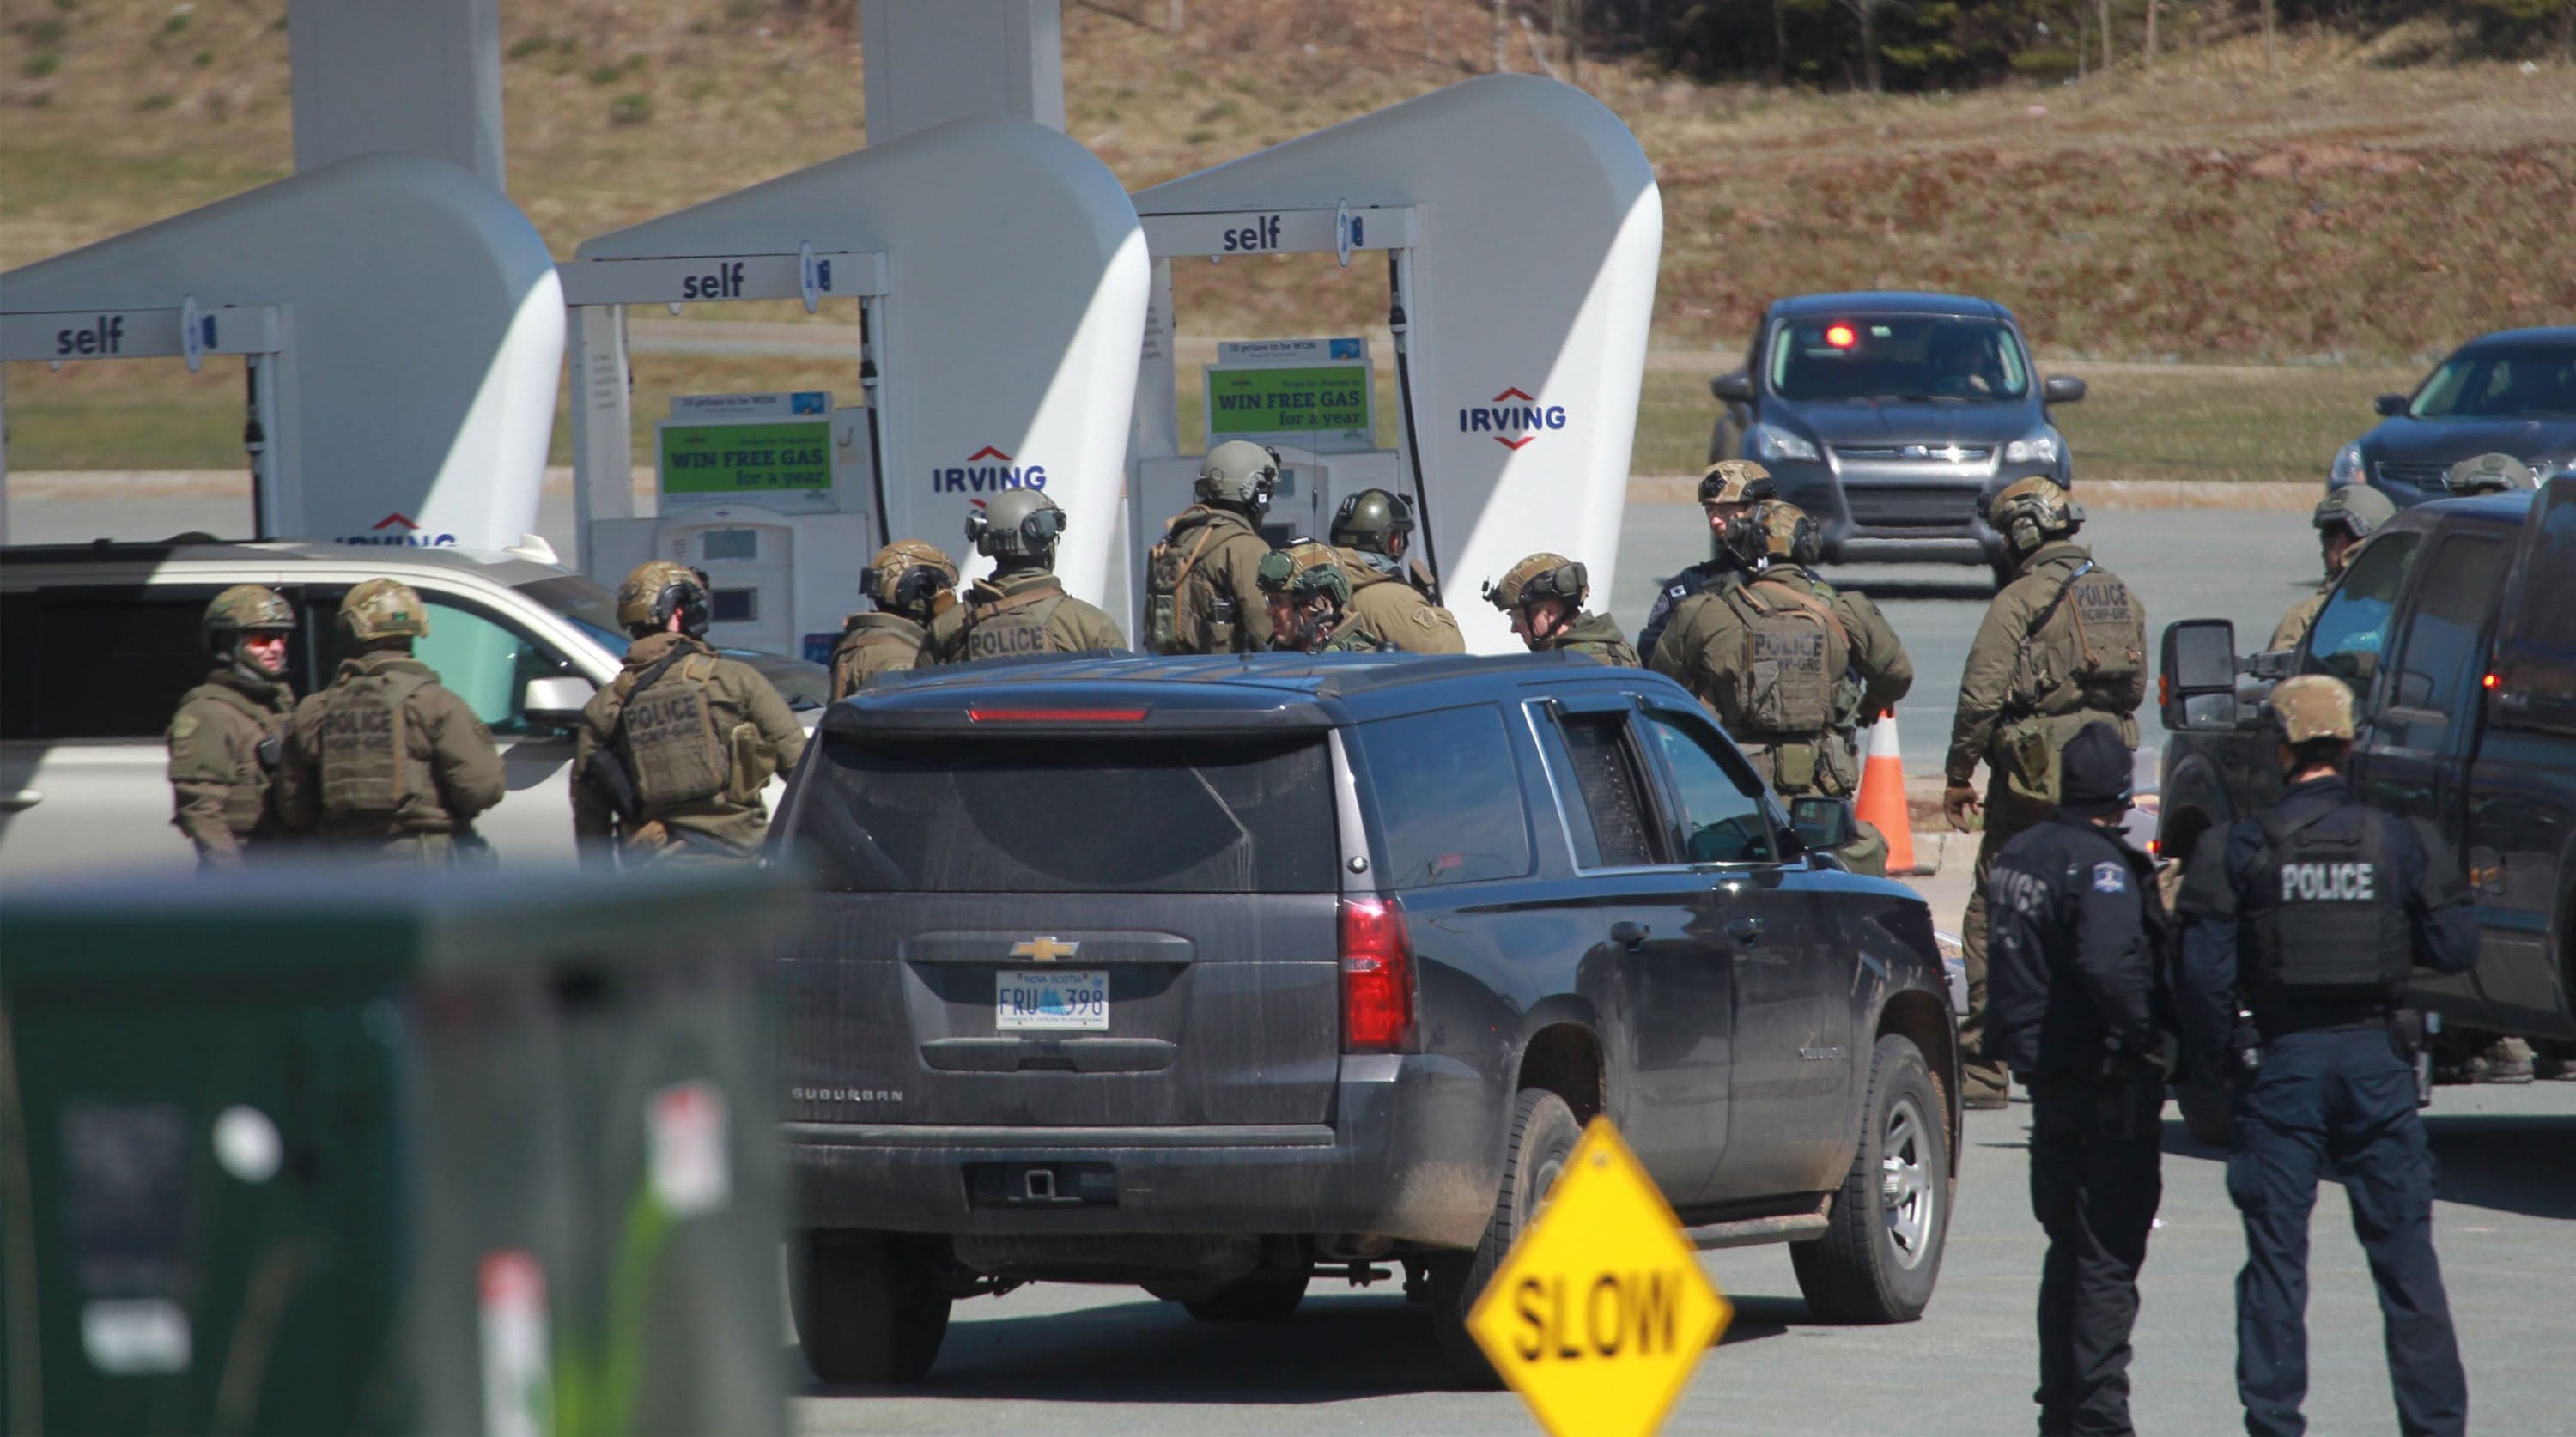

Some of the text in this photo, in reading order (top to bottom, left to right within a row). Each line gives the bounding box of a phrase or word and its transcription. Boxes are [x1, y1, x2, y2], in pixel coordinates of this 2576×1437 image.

[1224, 215, 1280, 251] self
[683, 261, 744, 299] self
[56, 314, 125, 355] self
[1291, 341, 1316, 350] WON
[1218, 391, 1360, 410] WIN FREE GAS
[1279, 411, 1361, 427] for a year
[1460, 406, 1566, 432] IRVING
[671, 448, 823, 470] WIN FREE GAS
[736, 470, 824, 488] for a year
[933, 465, 1047, 493] IRVING
[2074, 583, 2128, 607] POLICE
[971, 626, 1043, 657] POLICE
[1754, 633, 1823, 656] POLICE
[325, 710, 392, 735] POLICE
[626, 695, 701, 730] POLICE
[2281, 863, 2374, 900] POLICE
[1024, 974, 1082, 984] NOVA SCOTIA
[999, 988, 1103, 1015] FRU 398
[791, 1087, 903, 1102] SUBURBAN
[1513, 1273, 1682, 1362] SLOW
